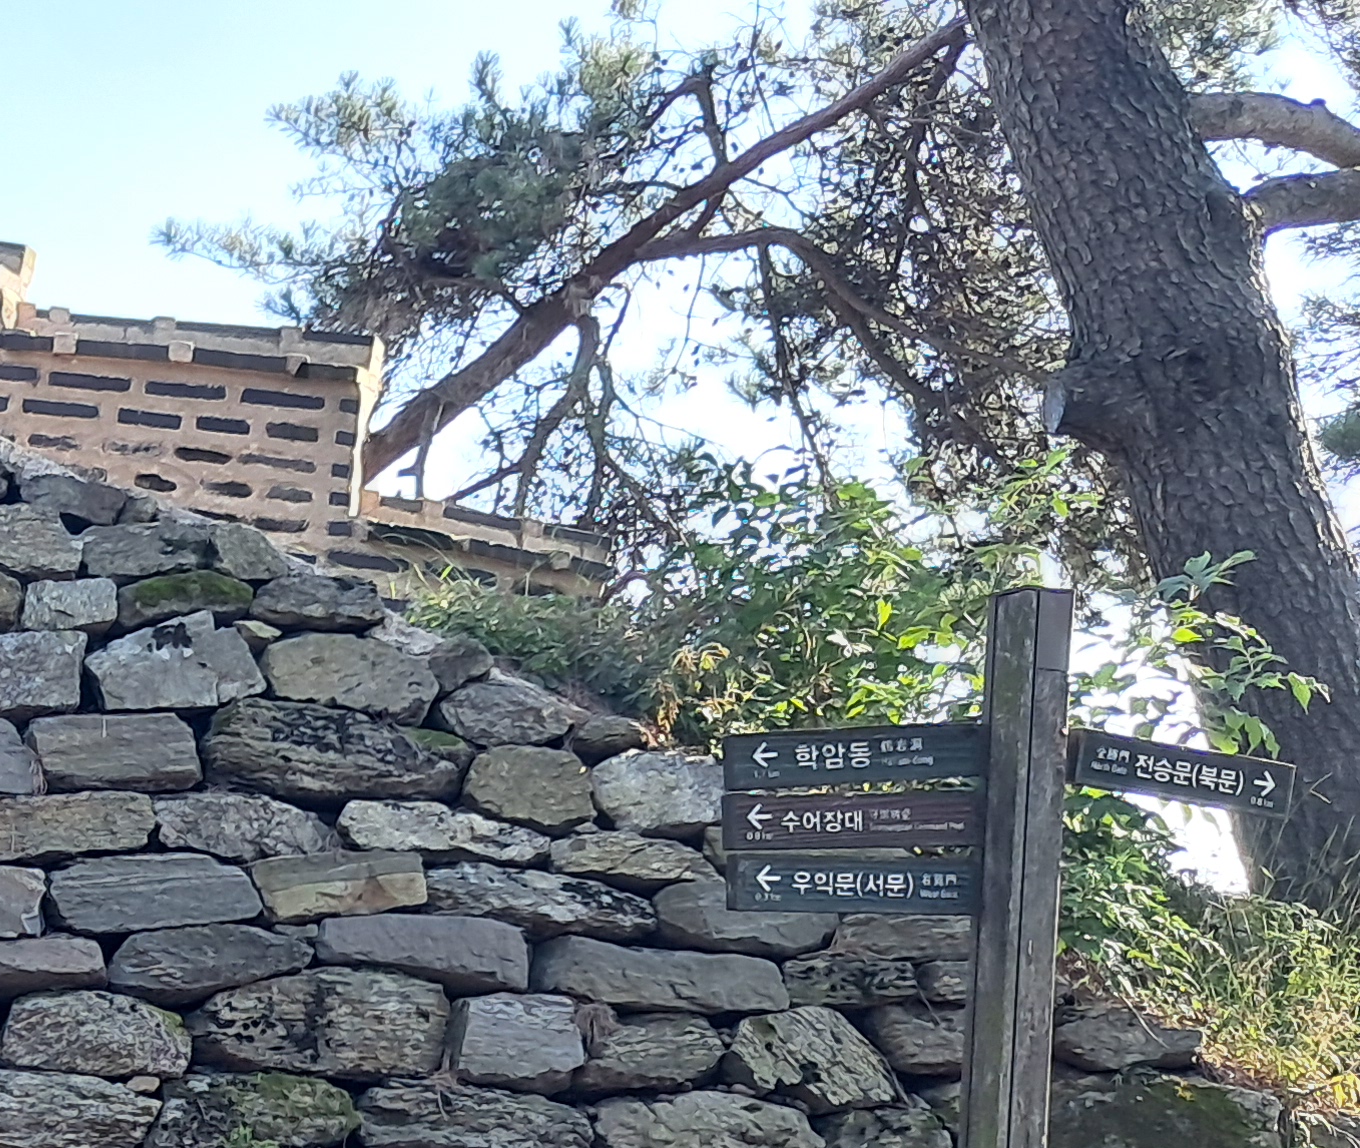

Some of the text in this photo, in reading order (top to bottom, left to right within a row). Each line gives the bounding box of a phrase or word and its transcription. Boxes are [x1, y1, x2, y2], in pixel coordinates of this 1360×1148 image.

[795, 741, 873, 771] 학암동
[1134, 754, 1245, 796] 전승문(북문)
[781, 809, 864, 833] 수어장대
[791, 870, 914, 899] 우익문(서문)
